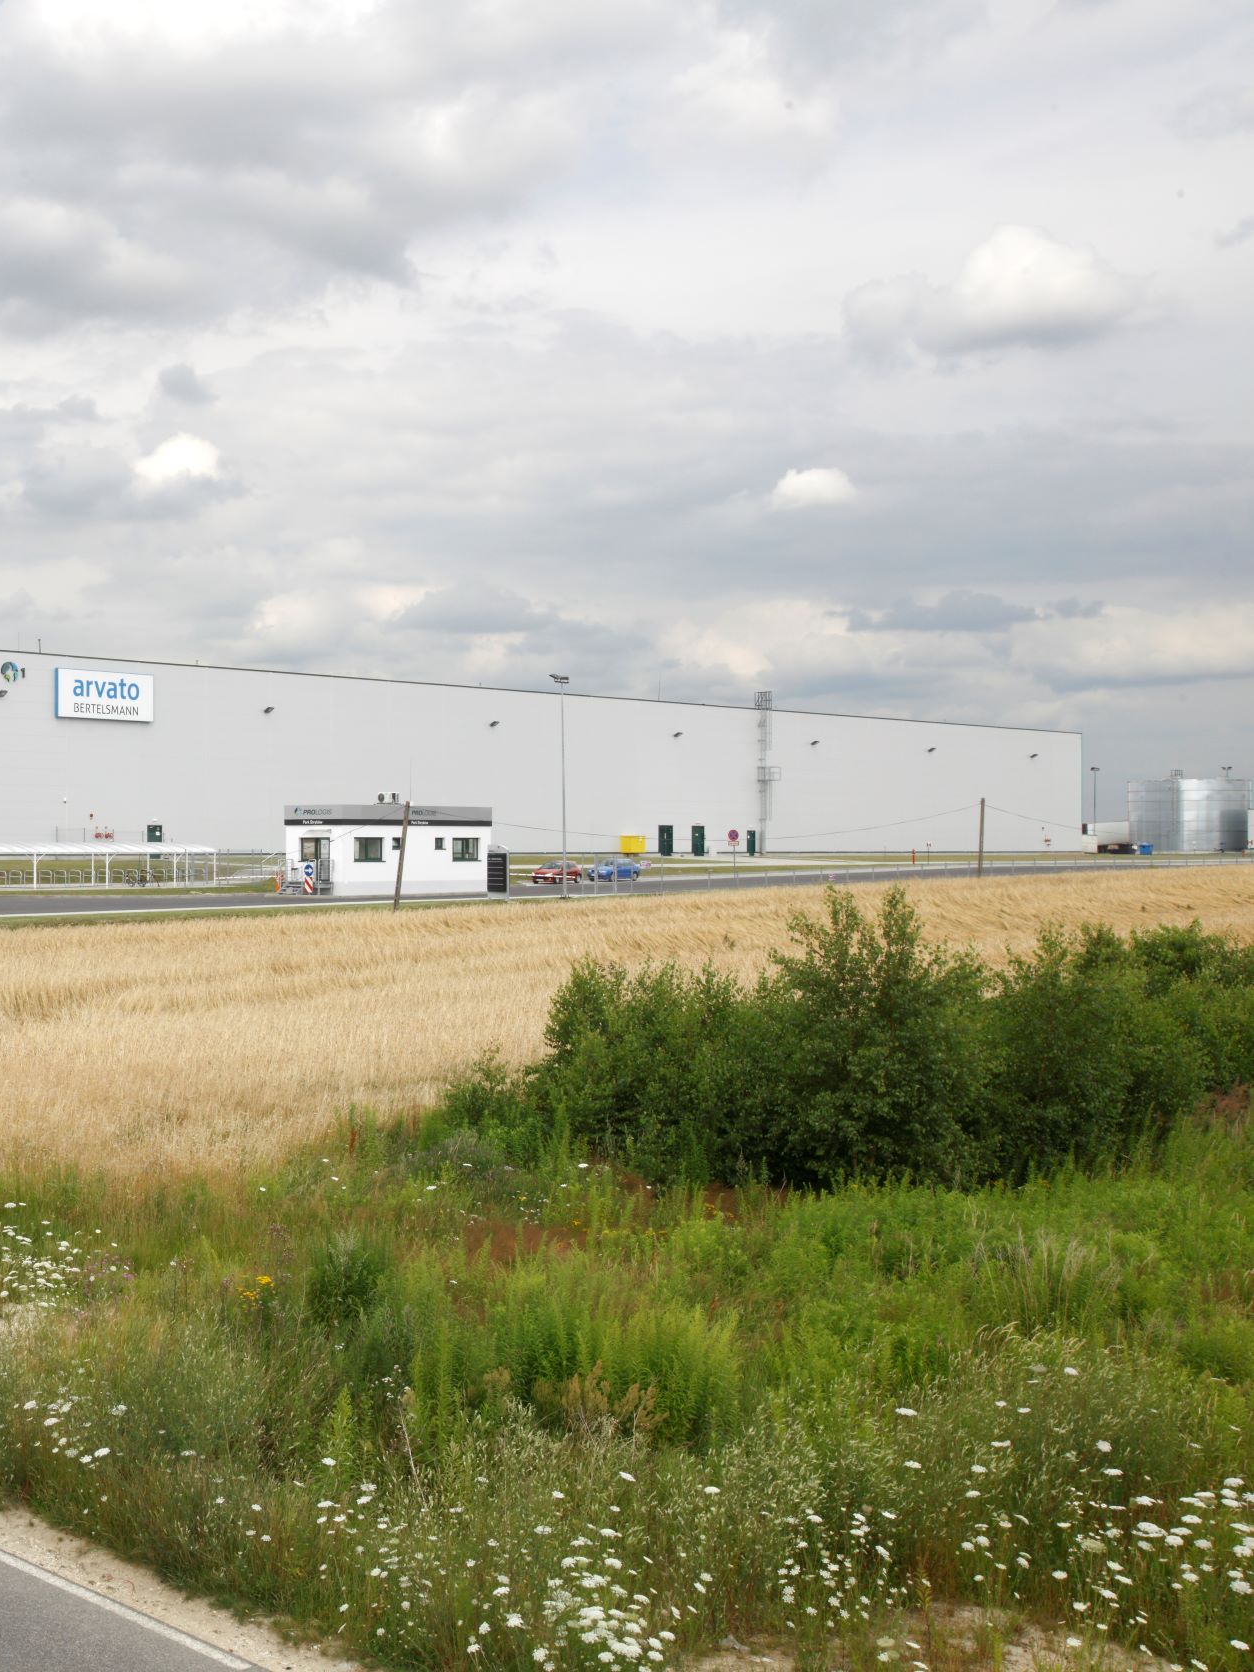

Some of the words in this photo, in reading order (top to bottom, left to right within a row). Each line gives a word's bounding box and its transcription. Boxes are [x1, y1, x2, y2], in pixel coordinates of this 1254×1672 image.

[20, 667, 26, 679] 1
[73, 678, 140, 701] arvato
[73, 702, 139, 716] BERTELSMANN
